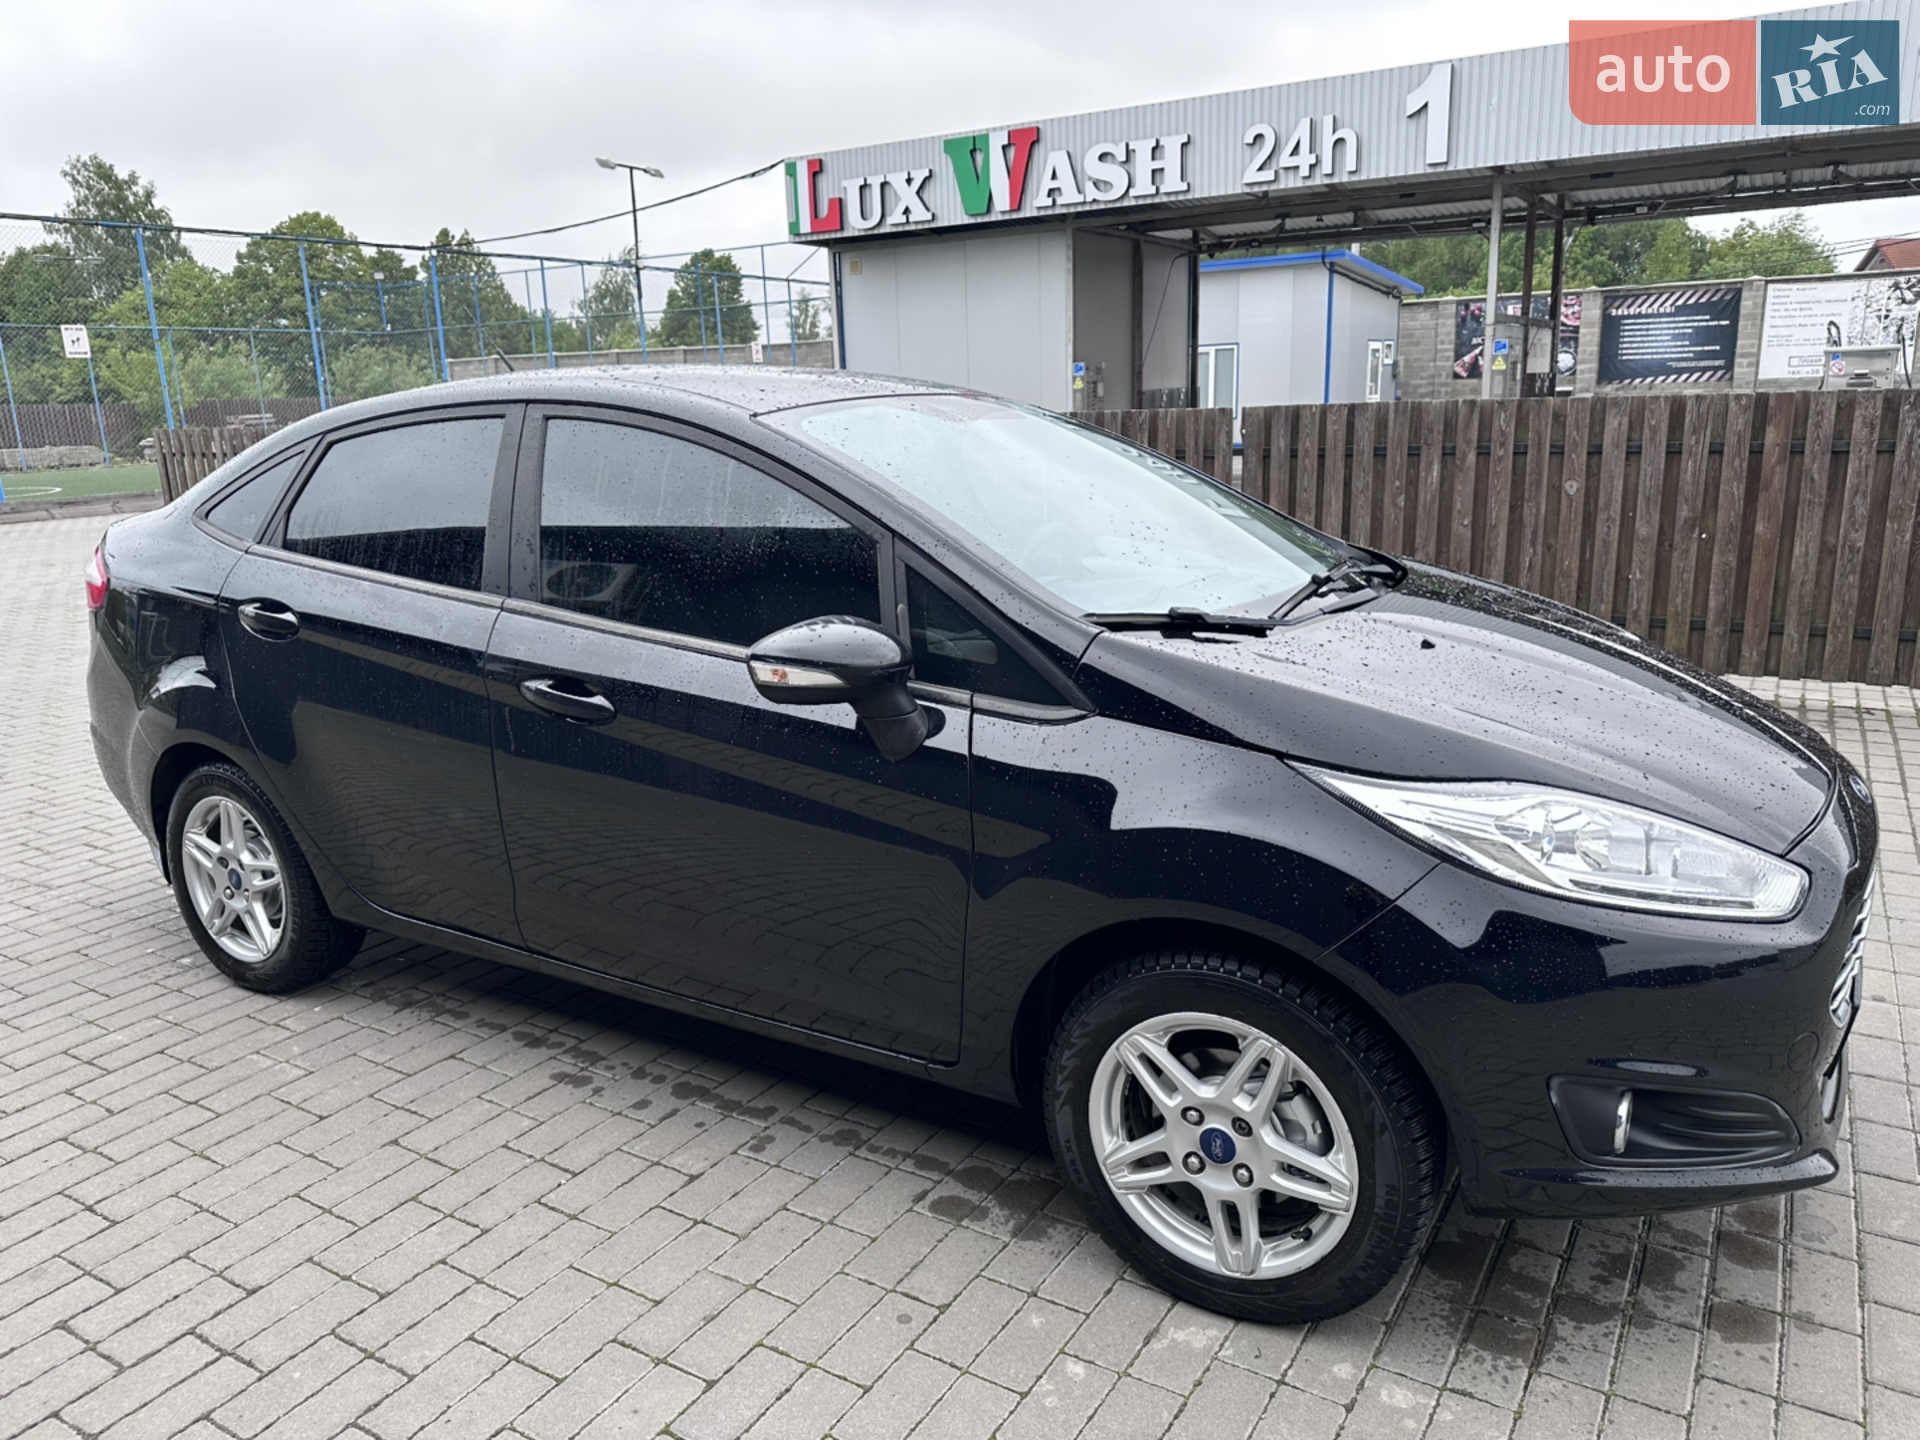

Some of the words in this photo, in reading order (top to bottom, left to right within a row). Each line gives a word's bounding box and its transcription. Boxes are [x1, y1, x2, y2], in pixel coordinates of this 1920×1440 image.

[786, 158, 935, 235] LUX
[943, 126, 1191, 217] WASH
[1242, 113, 1360, 185] 24h
[1406, 62, 1453, 166] 1
